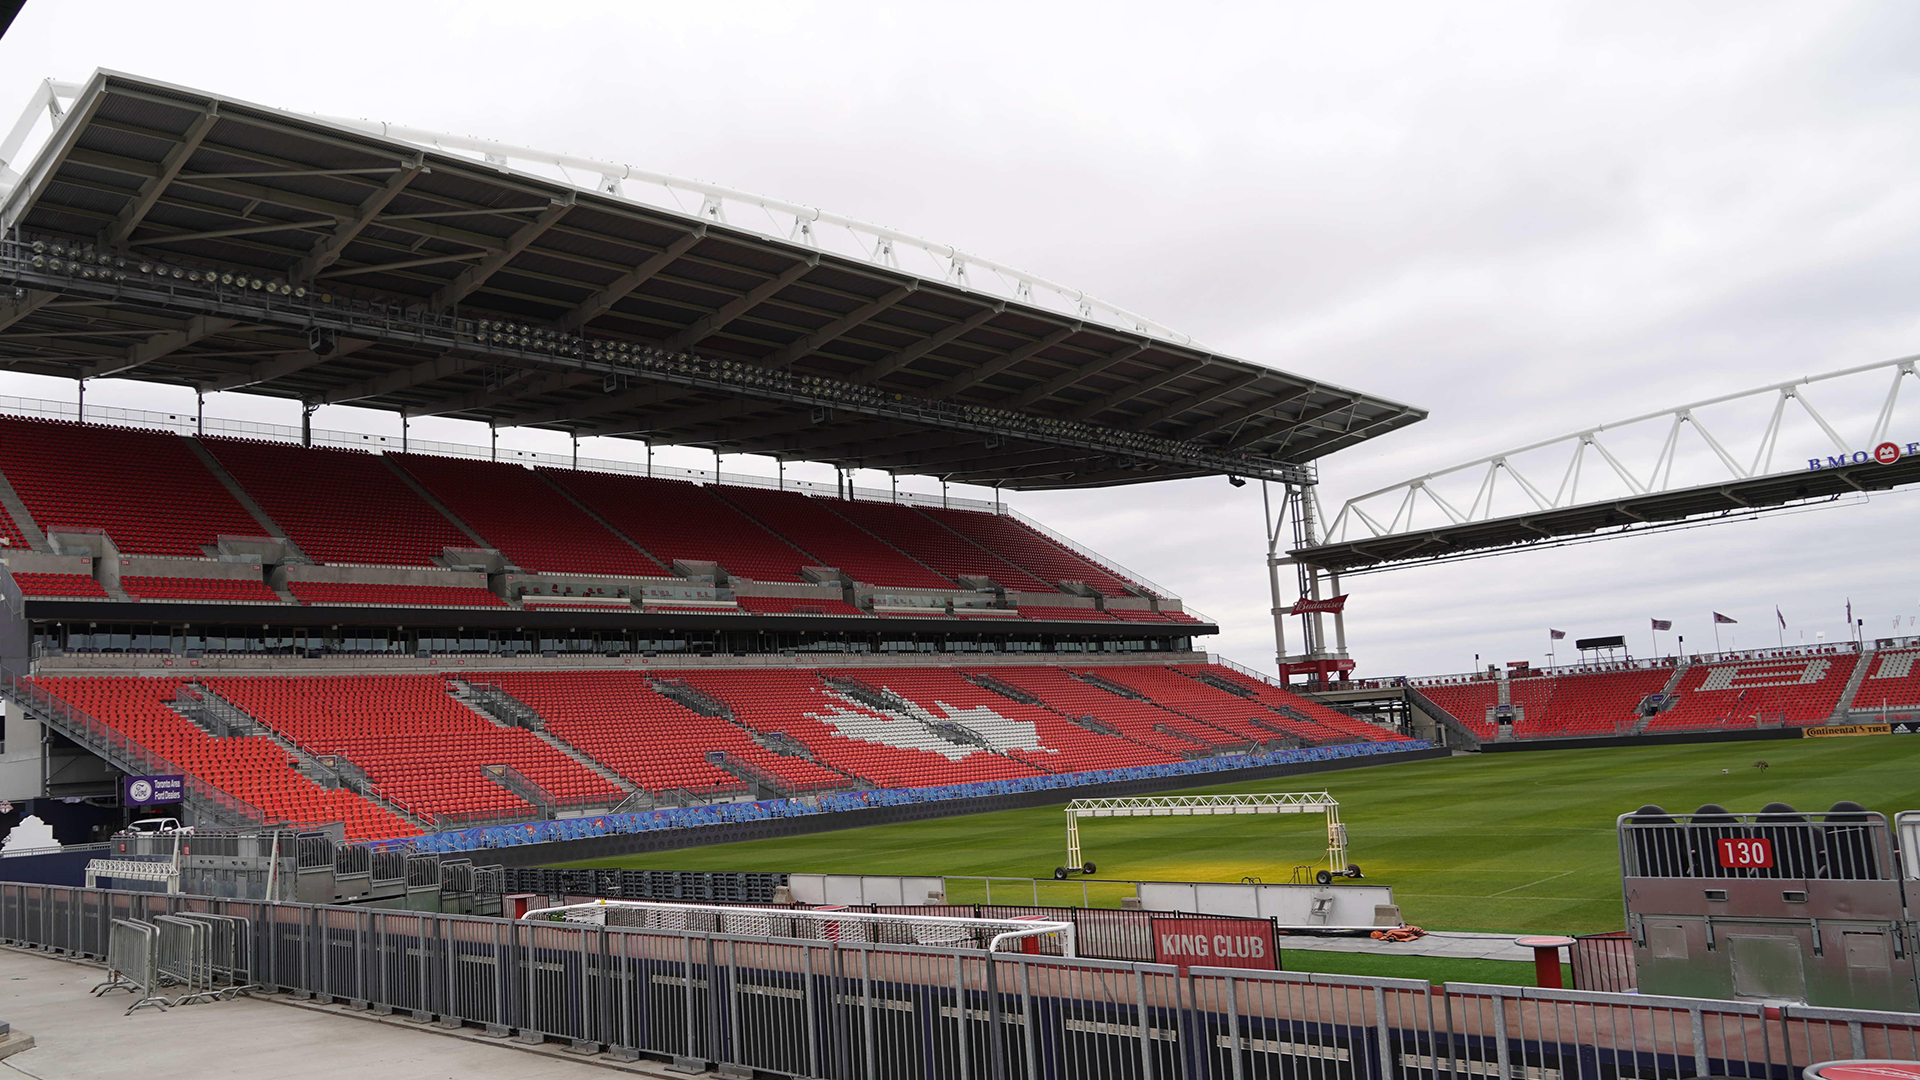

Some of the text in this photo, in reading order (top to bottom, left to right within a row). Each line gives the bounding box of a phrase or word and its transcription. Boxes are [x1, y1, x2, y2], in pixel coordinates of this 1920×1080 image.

[1807, 450, 1868, 471] BMO
[1295, 599, 1345, 611] Budweiser
[1806, 725, 1889, 737] Continental TIRE
[154, 779, 181, 789] Toronto Area
[154, 790, 181, 800] Ford Dealers
[1724, 841, 1765, 865] 130
[1161, 933, 1209, 957] KING
[1213, 935, 1265, 958] CLUB
